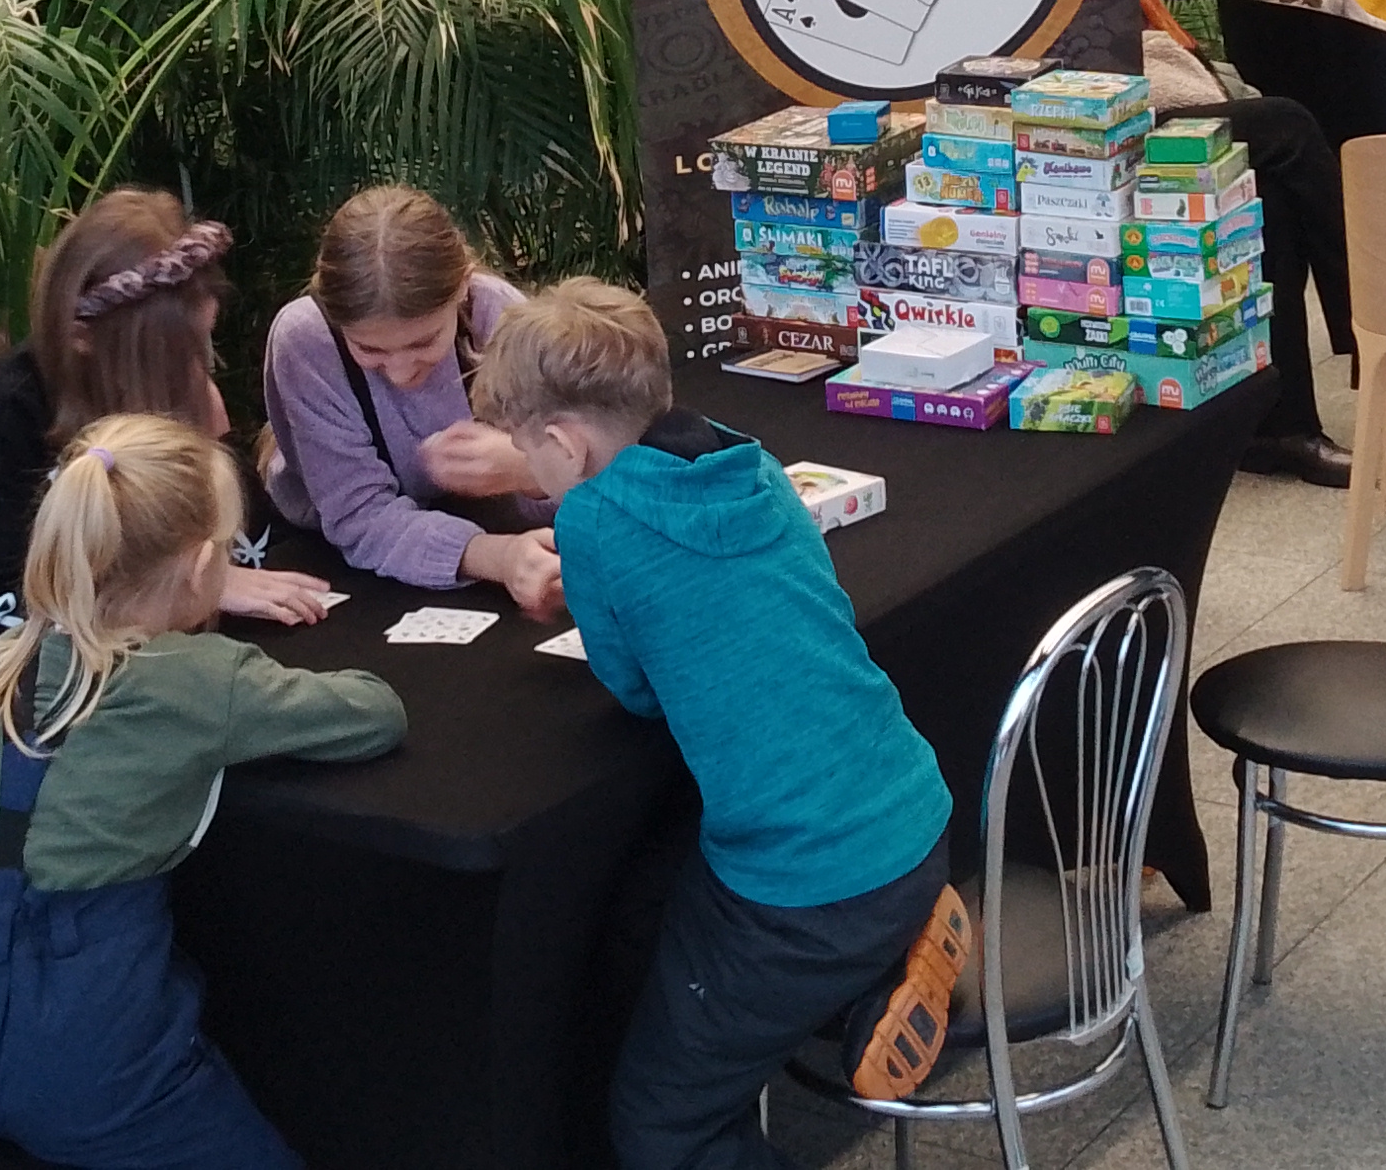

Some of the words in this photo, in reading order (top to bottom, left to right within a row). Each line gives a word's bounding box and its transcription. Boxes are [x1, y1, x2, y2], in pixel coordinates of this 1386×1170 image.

[744, 145, 757, 158] W
[760, 147, 819, 163] KRAINIE
[756, 160, 812, 176] LEGEND
[903, 254, 954, 278] TAFL
[894, 299, 976, 329] Qwirkle
[778, 330, 835, 352] CEZAR
